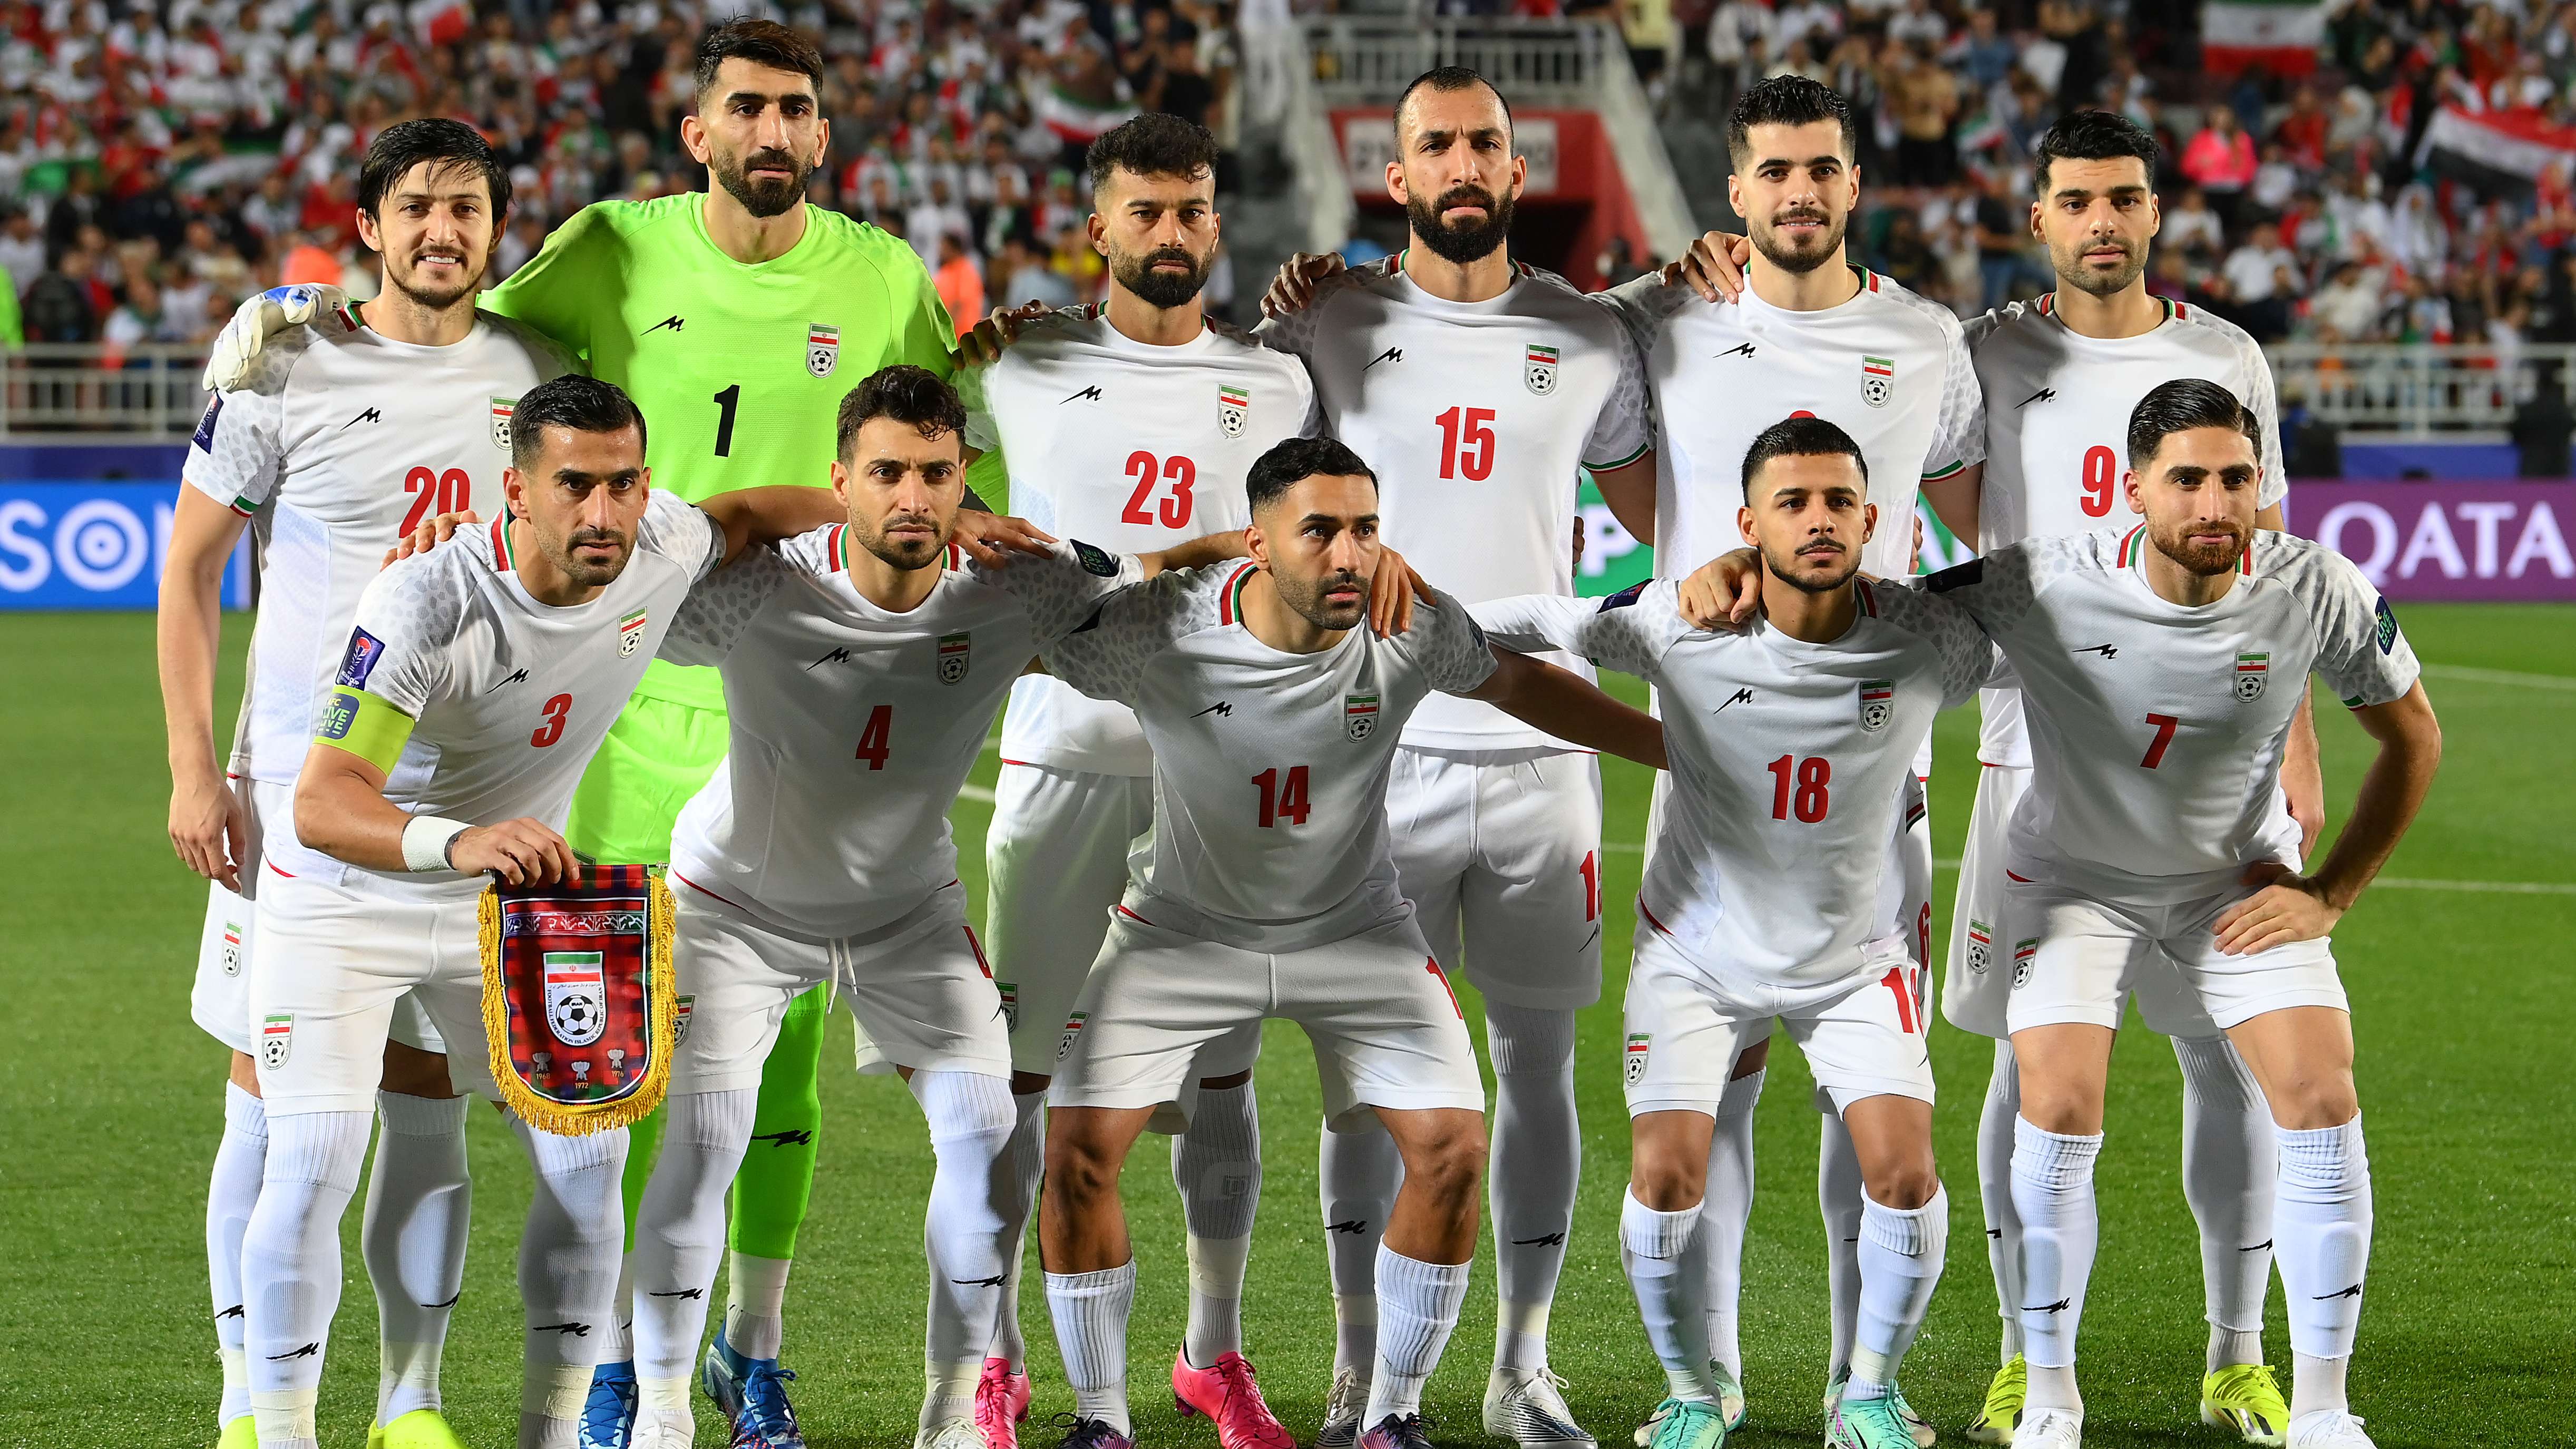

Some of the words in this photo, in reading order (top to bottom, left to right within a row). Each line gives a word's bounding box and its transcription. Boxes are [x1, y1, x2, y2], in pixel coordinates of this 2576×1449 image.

[714, 384, 740, 457] 1
[1435, 406, 1496, 481] 15
[398, 466, 470, 539] 20
[1121, 451, 1195, 529] 23
[2080, 445, 2115, 517] 9
[530, 693, 572, 748] 3
[855, 705, 893, 770] 4
[2140, 712, 2179, 769] 7
[1251, 766, 1311, 828] 14
[1768, 754, 1831, 823] 18
[551, 1019, 573, 1043] FEDERATION
[574, 1033, 597, 1044] ISLAMIC
